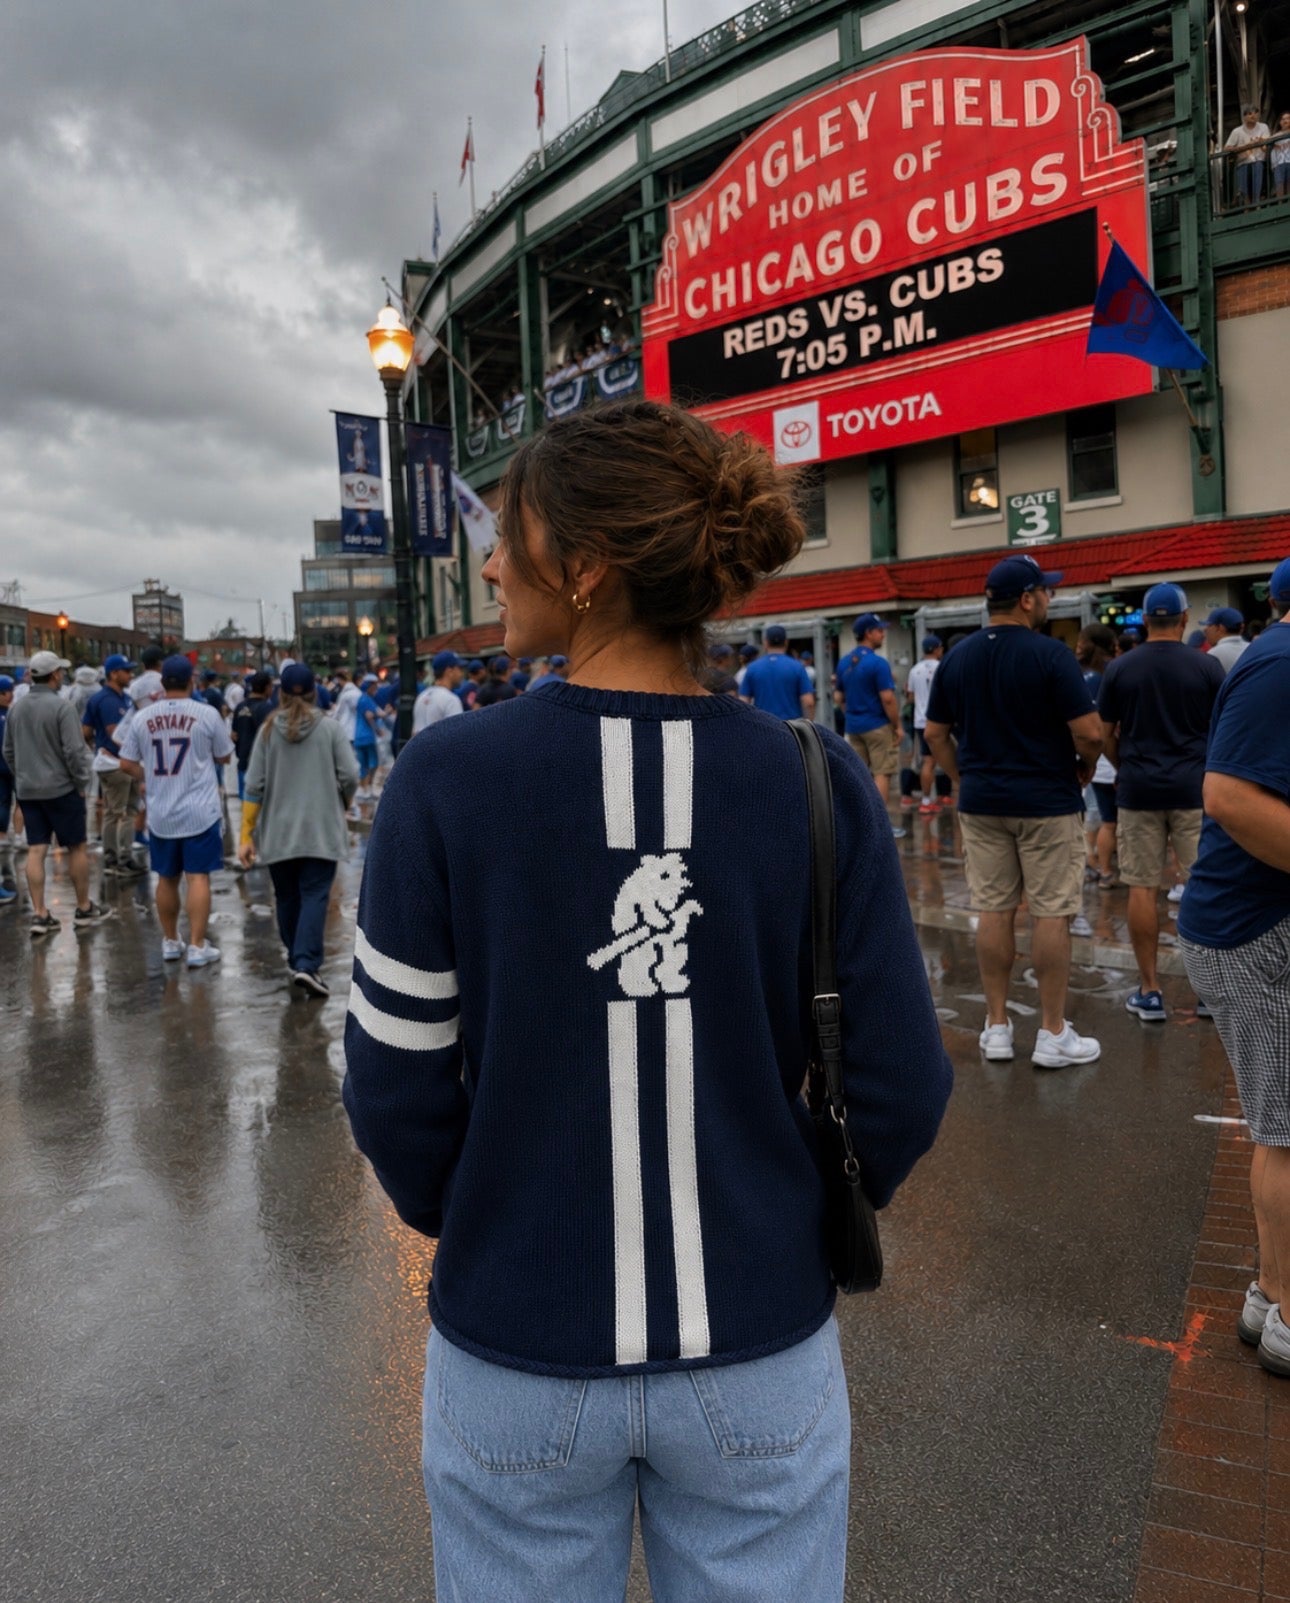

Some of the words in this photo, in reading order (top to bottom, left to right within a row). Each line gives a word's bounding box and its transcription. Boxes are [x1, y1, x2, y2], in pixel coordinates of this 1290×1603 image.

[682, 91, 877, 258] WRIGLEY
[901, 78, 1061, 129] FIELD
[769, 168, 868, 229] HOME
[893, 140, 942, 181] OF
[684, 218, 882, 319] CHICAGO
[907, 152, 1067, 245] CUBS
[723, 307, 809, 359] REDS
[818, 290, 878, 328] VS.
[889, 248, 1004, 308] CUBS
[776, 333, 847, 379] 7:05
[859, 311, 937, 357] P.M.
[826, 391, 942, 438] TOYOTA
[1010, 490, 1056, 508] GATE
[1016, 505, 1050, 537] 3
[147, 714, 196, 734] BRYANT
[152, 737, 190, 776] 17
